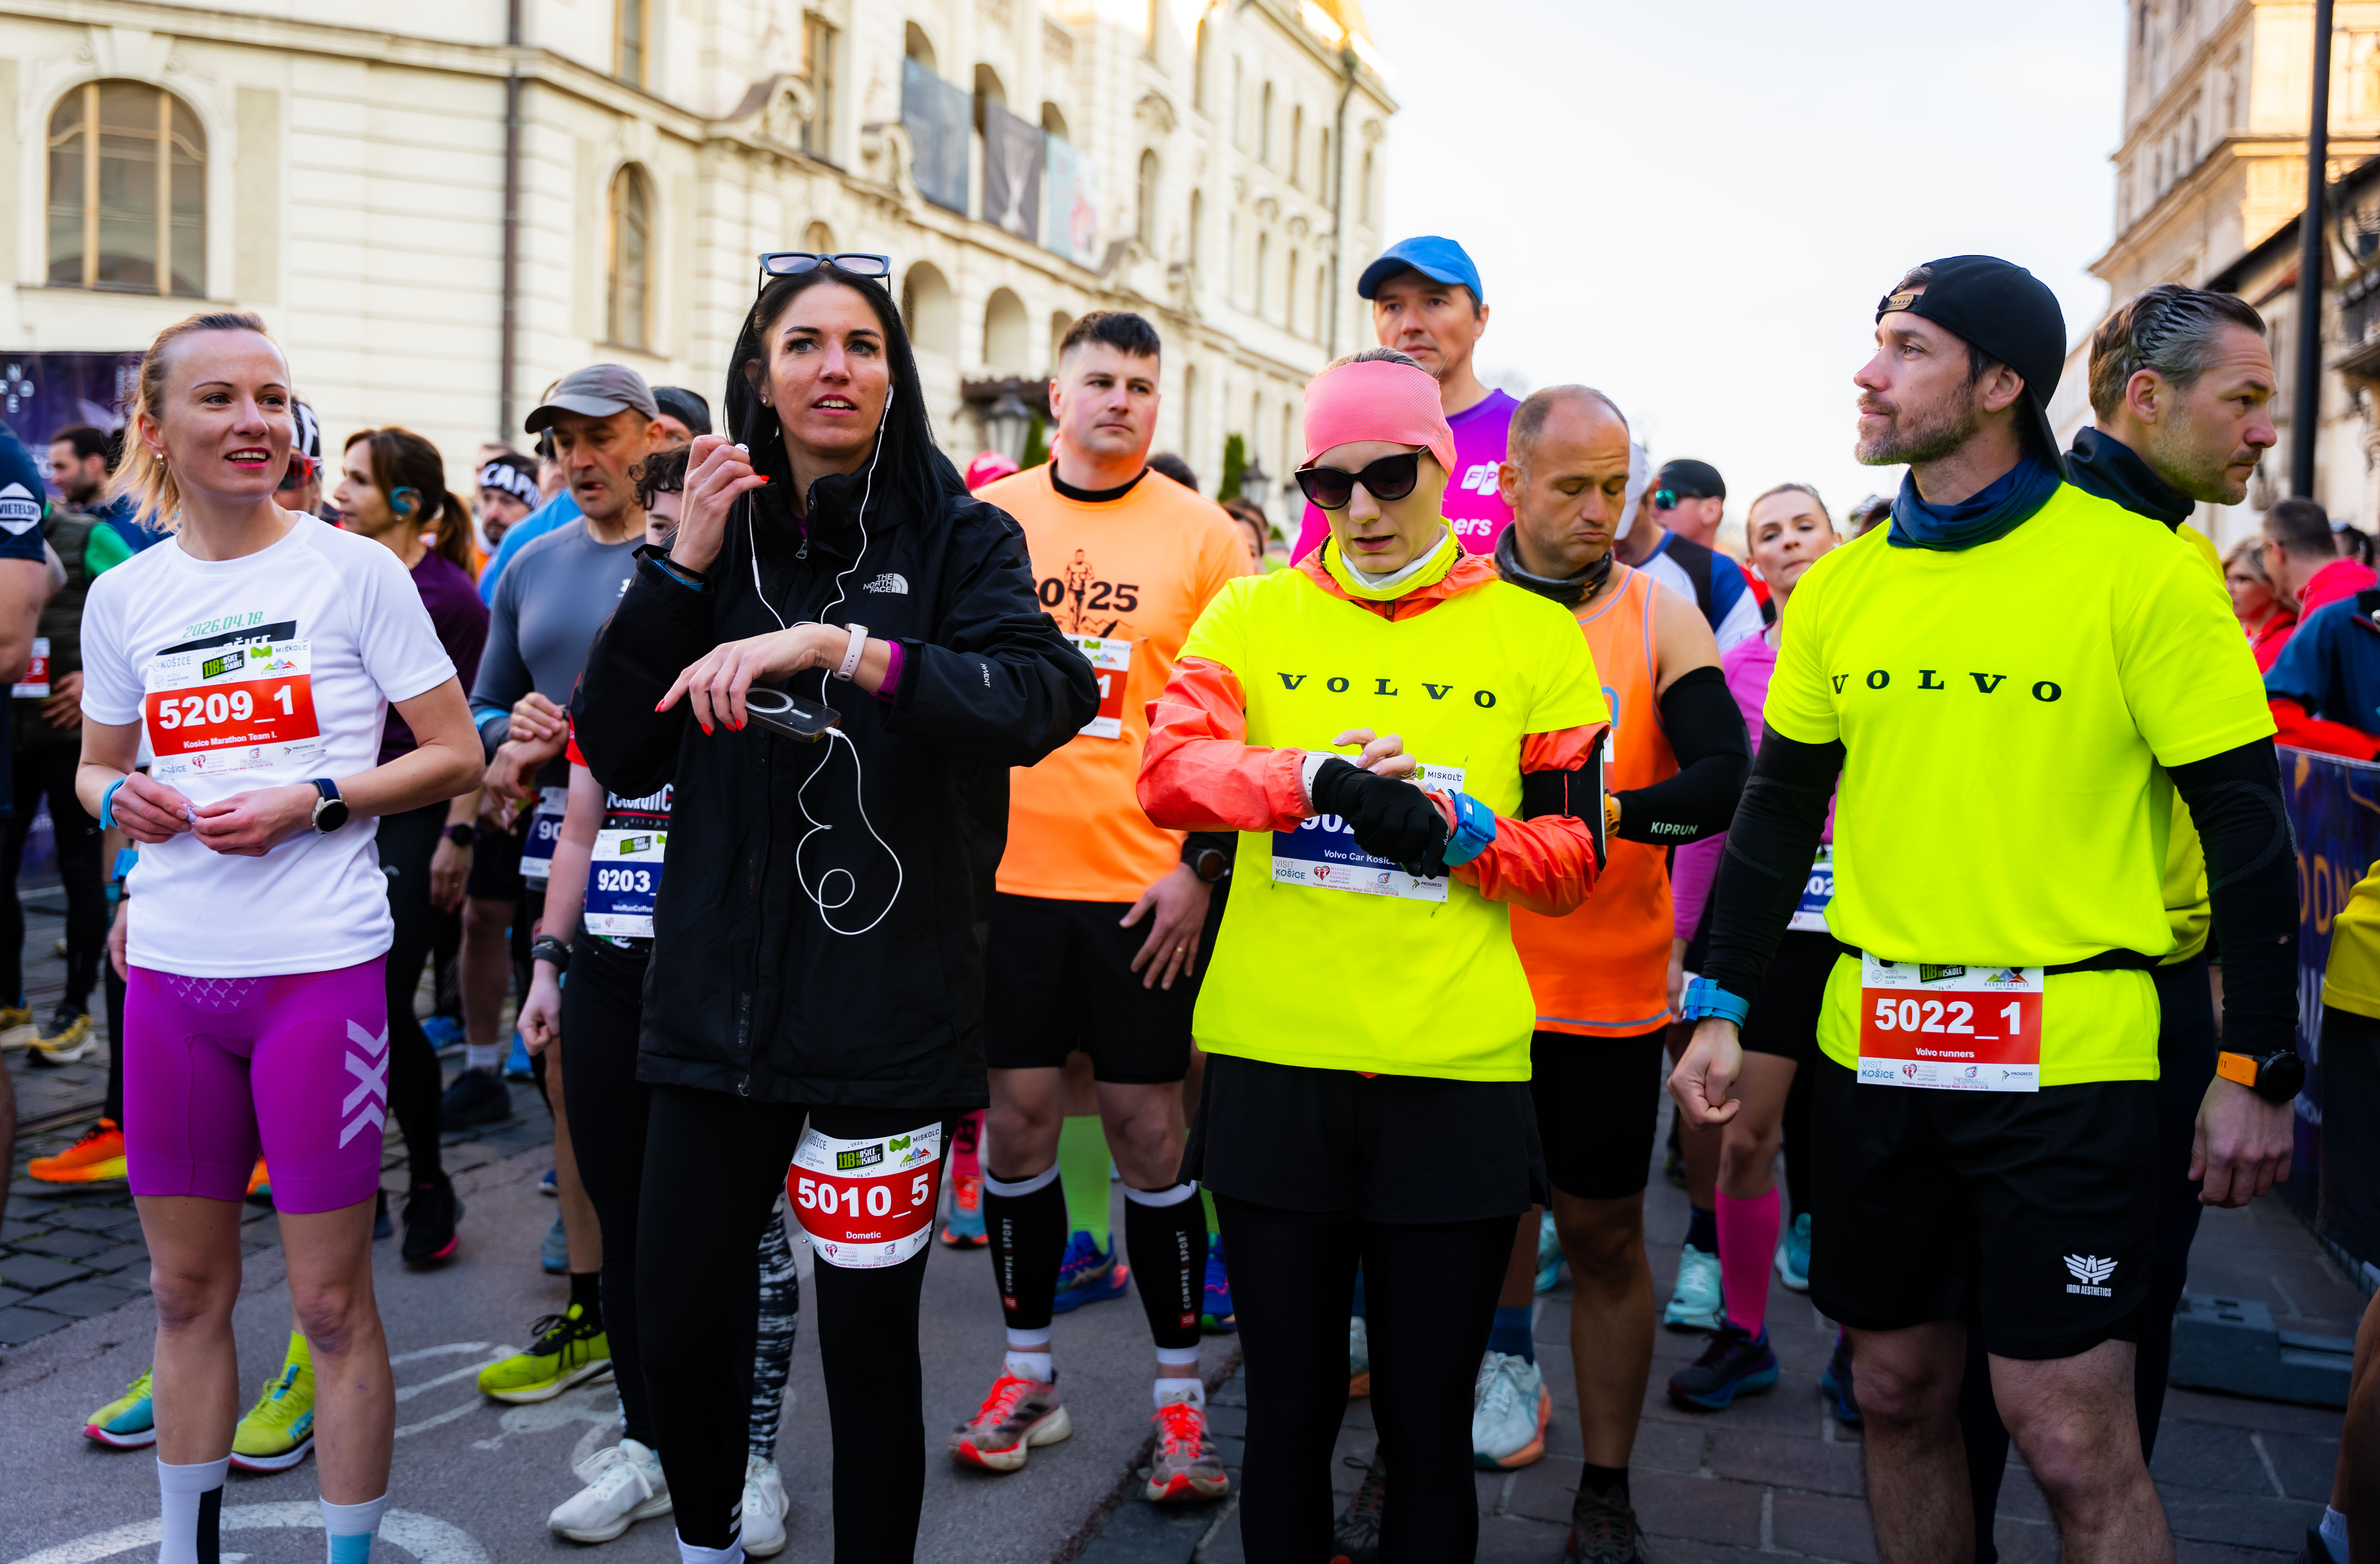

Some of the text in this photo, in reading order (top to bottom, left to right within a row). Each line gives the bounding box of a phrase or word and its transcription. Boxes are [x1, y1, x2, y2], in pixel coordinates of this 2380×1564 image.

[863, 580, 892, 590] NORTH
[183, 612, 264, 638] 2026.04.18.
[203, 659, 220, 678] 118
[980, 663, 990, 687] HYVENT
[1277, 672, 1496, 708] VOLVO
[1831, 669, 2062, 702] VOLVO
[159, 685, 294, 730] 5209_1
[183, 739, 209, 749] Kosice
[210, 735, 247, 745] Marathon
[248, 732, 270, 741] Team
[1427, 771, 1462, 781] MISKOLC
[1300, 814, 1355, 834] 90
[1650, 821, 1698, 836] KIPRUN
[1324, 850, 1347, 859] Volvo
[1349, 852, 1364, 861] Car
[1275, 859, 1294, 869] VISIT
[1921, 964, 1937, 980] 118
[1938, 967, 1963, 978] MISKOLC
[1874, 998, 2020, 1040] 5022_1
[1915, 1047, 1974, 1058] Volvo runners
[1862, 1060, 1883, 1068] VISIT
[913, 1128, 939, 1143] MISKOLC
[806, 1156, 825, 1165] MARATHON
[838, 1152, 856, 1168] 118
[856, 1153, 881, 1166] MISKOLC
[798, 1173, 929, 1219] 5010_5
[846, 1231, 881, 1240] Dometic
[2066, 1283, 2112, 1297] IRON AESTHETICS
